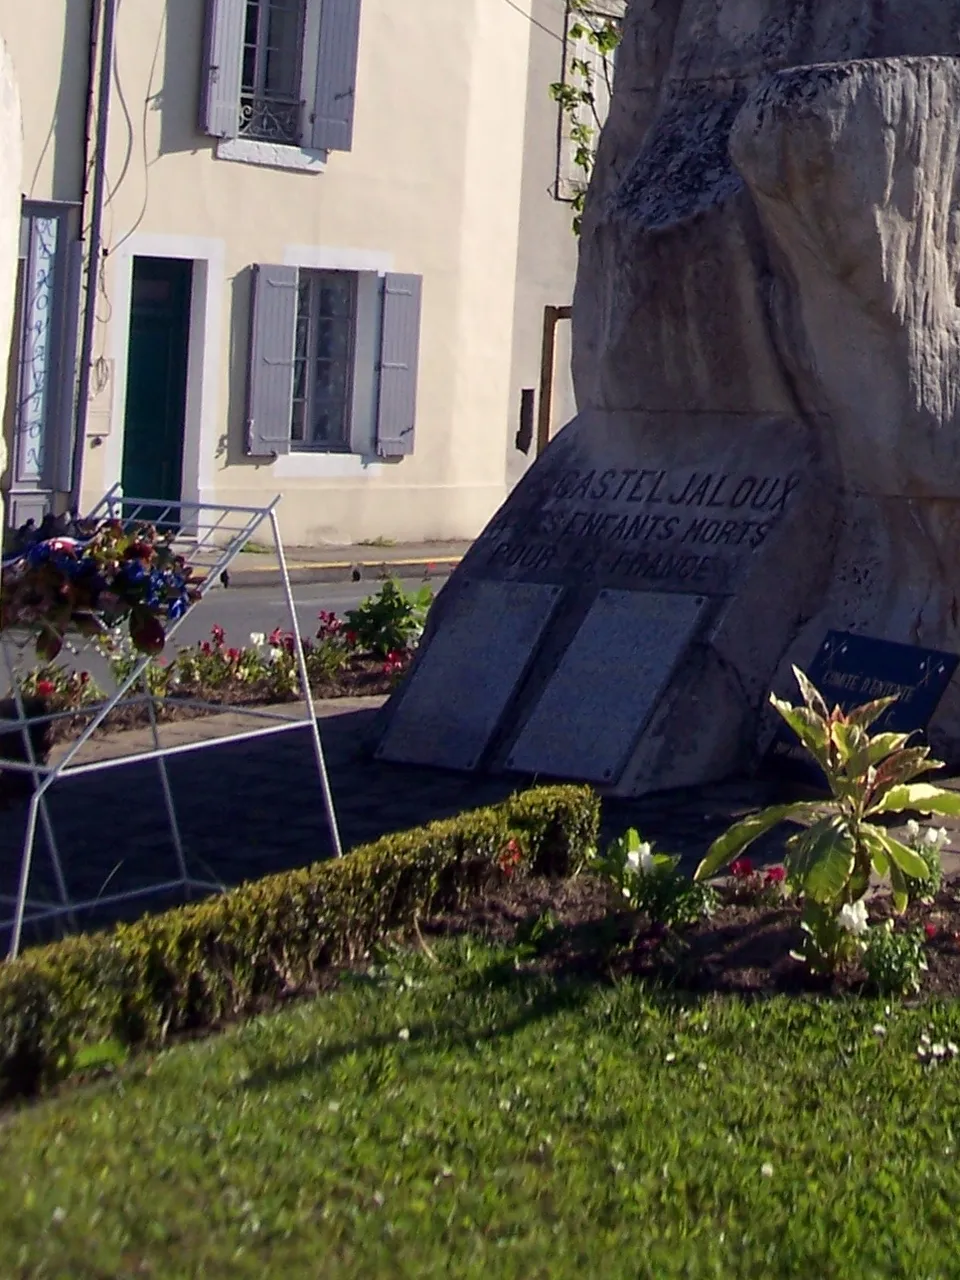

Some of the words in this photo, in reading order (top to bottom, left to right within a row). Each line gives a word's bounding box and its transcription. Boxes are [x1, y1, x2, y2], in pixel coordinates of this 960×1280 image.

[553, 468, 803, 512] CASTELJALOUX
[560, 511, 681, 541] ENFANTS
[680, 518, 772, 549] MORTS
[486, 543, 557, 570] POUR
[609, 550, 711, 582] FRANCE
